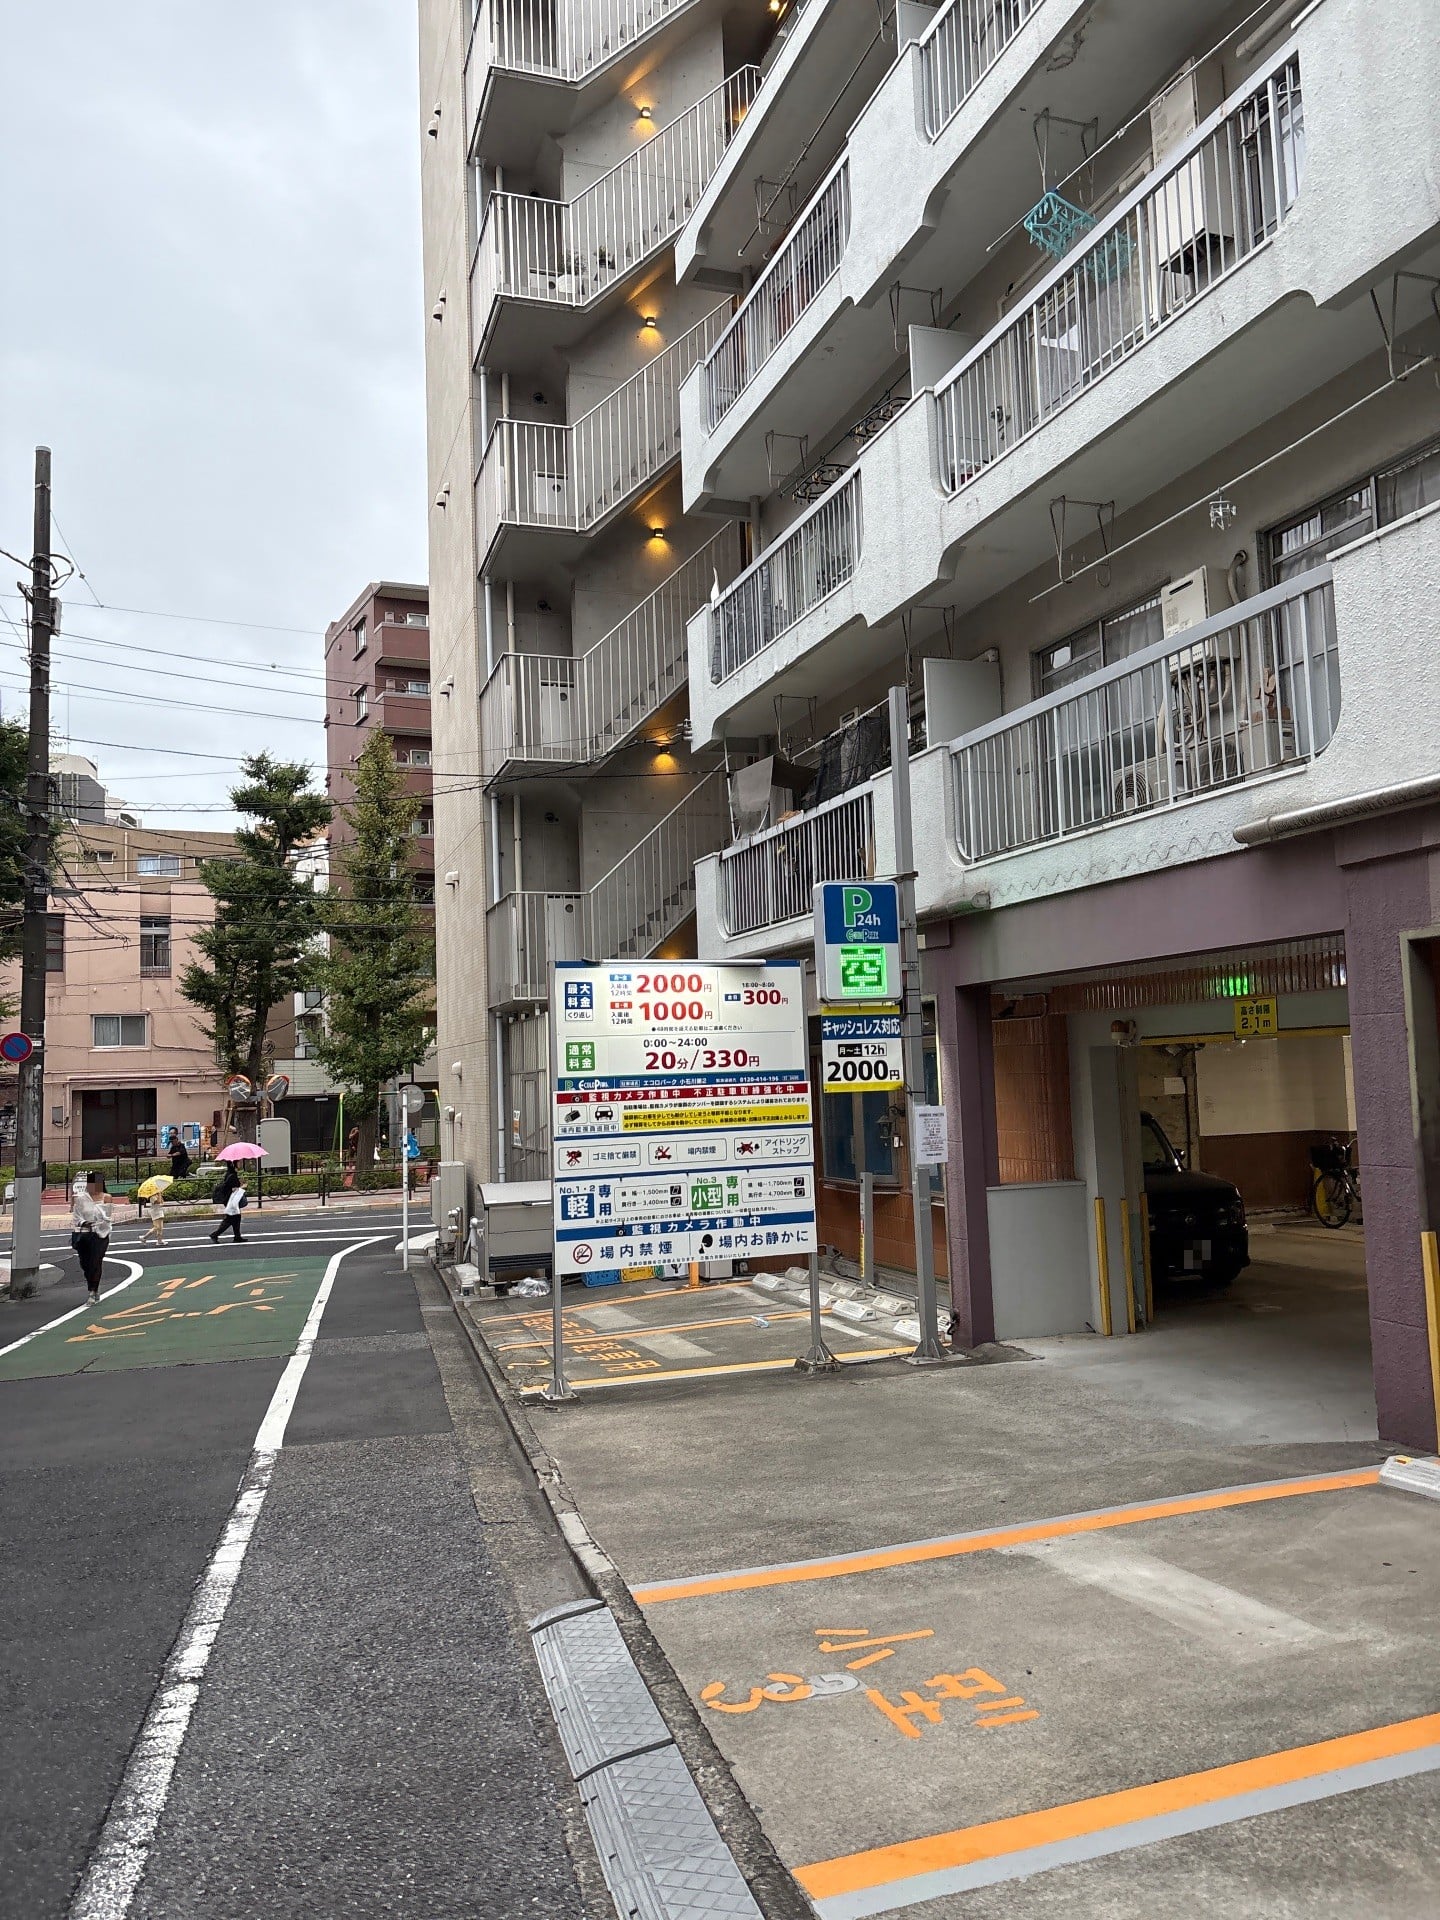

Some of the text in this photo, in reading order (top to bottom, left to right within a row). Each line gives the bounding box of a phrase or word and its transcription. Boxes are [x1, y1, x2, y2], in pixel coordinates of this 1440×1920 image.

[842, 887, 873, 927] P
[857, 914, 881, 926] 24h
[567, 983, 591, 995] 最大
[637, 974, 712, 993] 2000円
[567, 997, 591, 1008] 料金
[743, 989, 789, 1005] 300円
[639, 1001, 713, 1021] 1000円
[822, 1018, 900, 1036] キャッシュレス対応
[568, 1044, 592, 1056] 通常
[568, 1057, 592, 1069] 料金
[827, 1060, 900, 1082] 2000円
[589, 1090, 680, 1101] 監視カメラ作動中
[687, 1146, 717, 1155] 場内禁煙
[765, 1137, 806, 1147] アイドリング
[772, 1146, 800, 1155] ストップ
[592, 1151, 637, 1161] ゴミ捨て厳禁
[696, 1176, 717, 1184] No.3
[692, 1186, 722, 1208] 小型
[726, 1176, 739, 1206] 専用
[567, 1195, 589, 1218] 軽
[598, 1184, 612, 1216] 専用
[632, 1215, 761, 1236] 監視カメラ作動中
[719, 1230, 809, 1248] 場内お静かに
[600, 1241, 673, 1259] 場内禁煙
